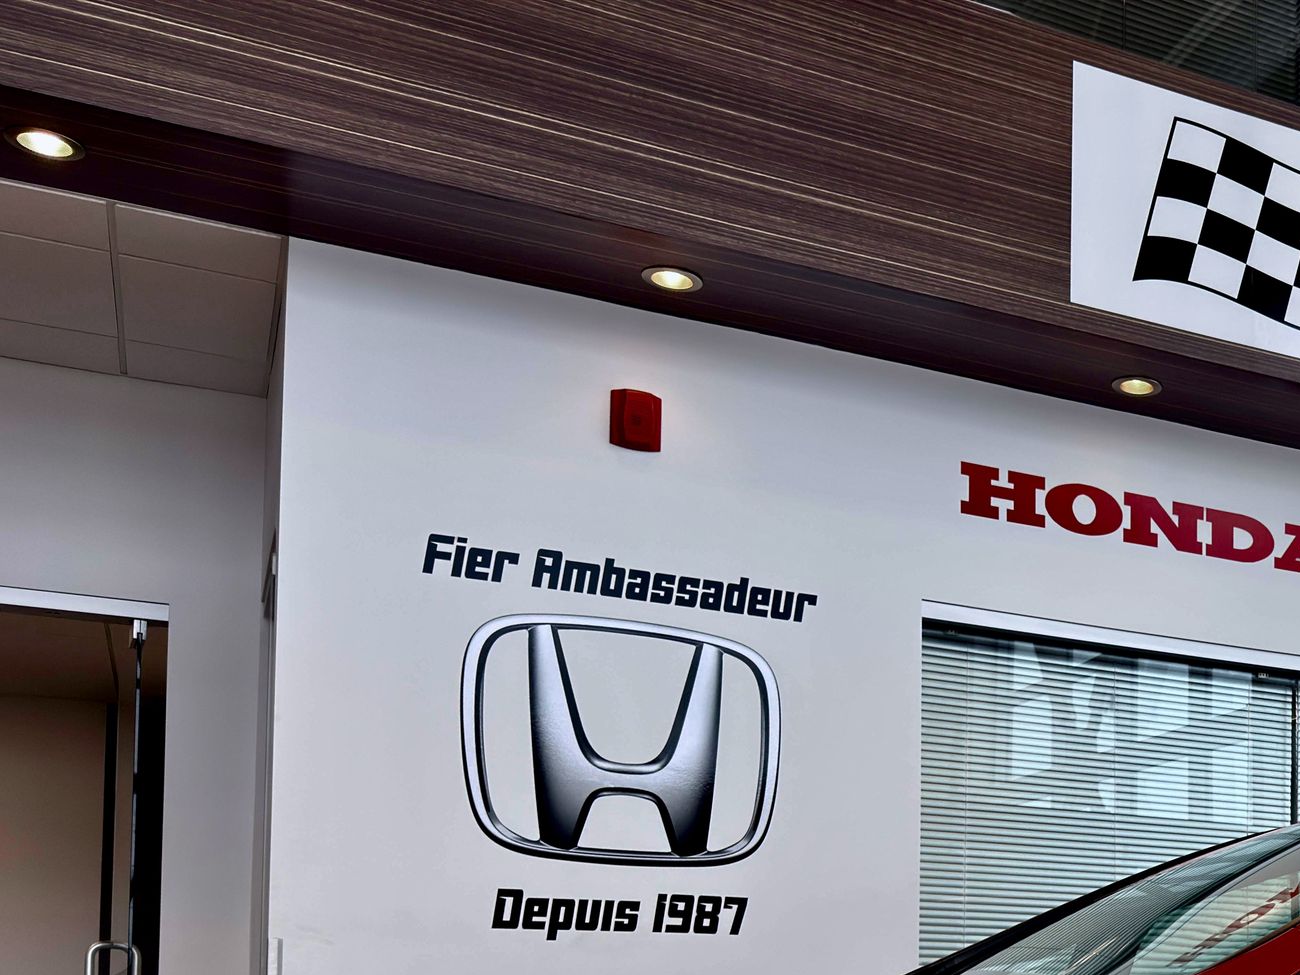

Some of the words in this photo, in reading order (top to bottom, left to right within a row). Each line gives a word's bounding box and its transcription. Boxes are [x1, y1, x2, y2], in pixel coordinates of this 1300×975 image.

[422, 534, 519, 583] Fier
[531, 549, 818, 624] Ambassadeur
[491, 889, 640, 941] Depuis
[652, 894, 748, 935] 1987
